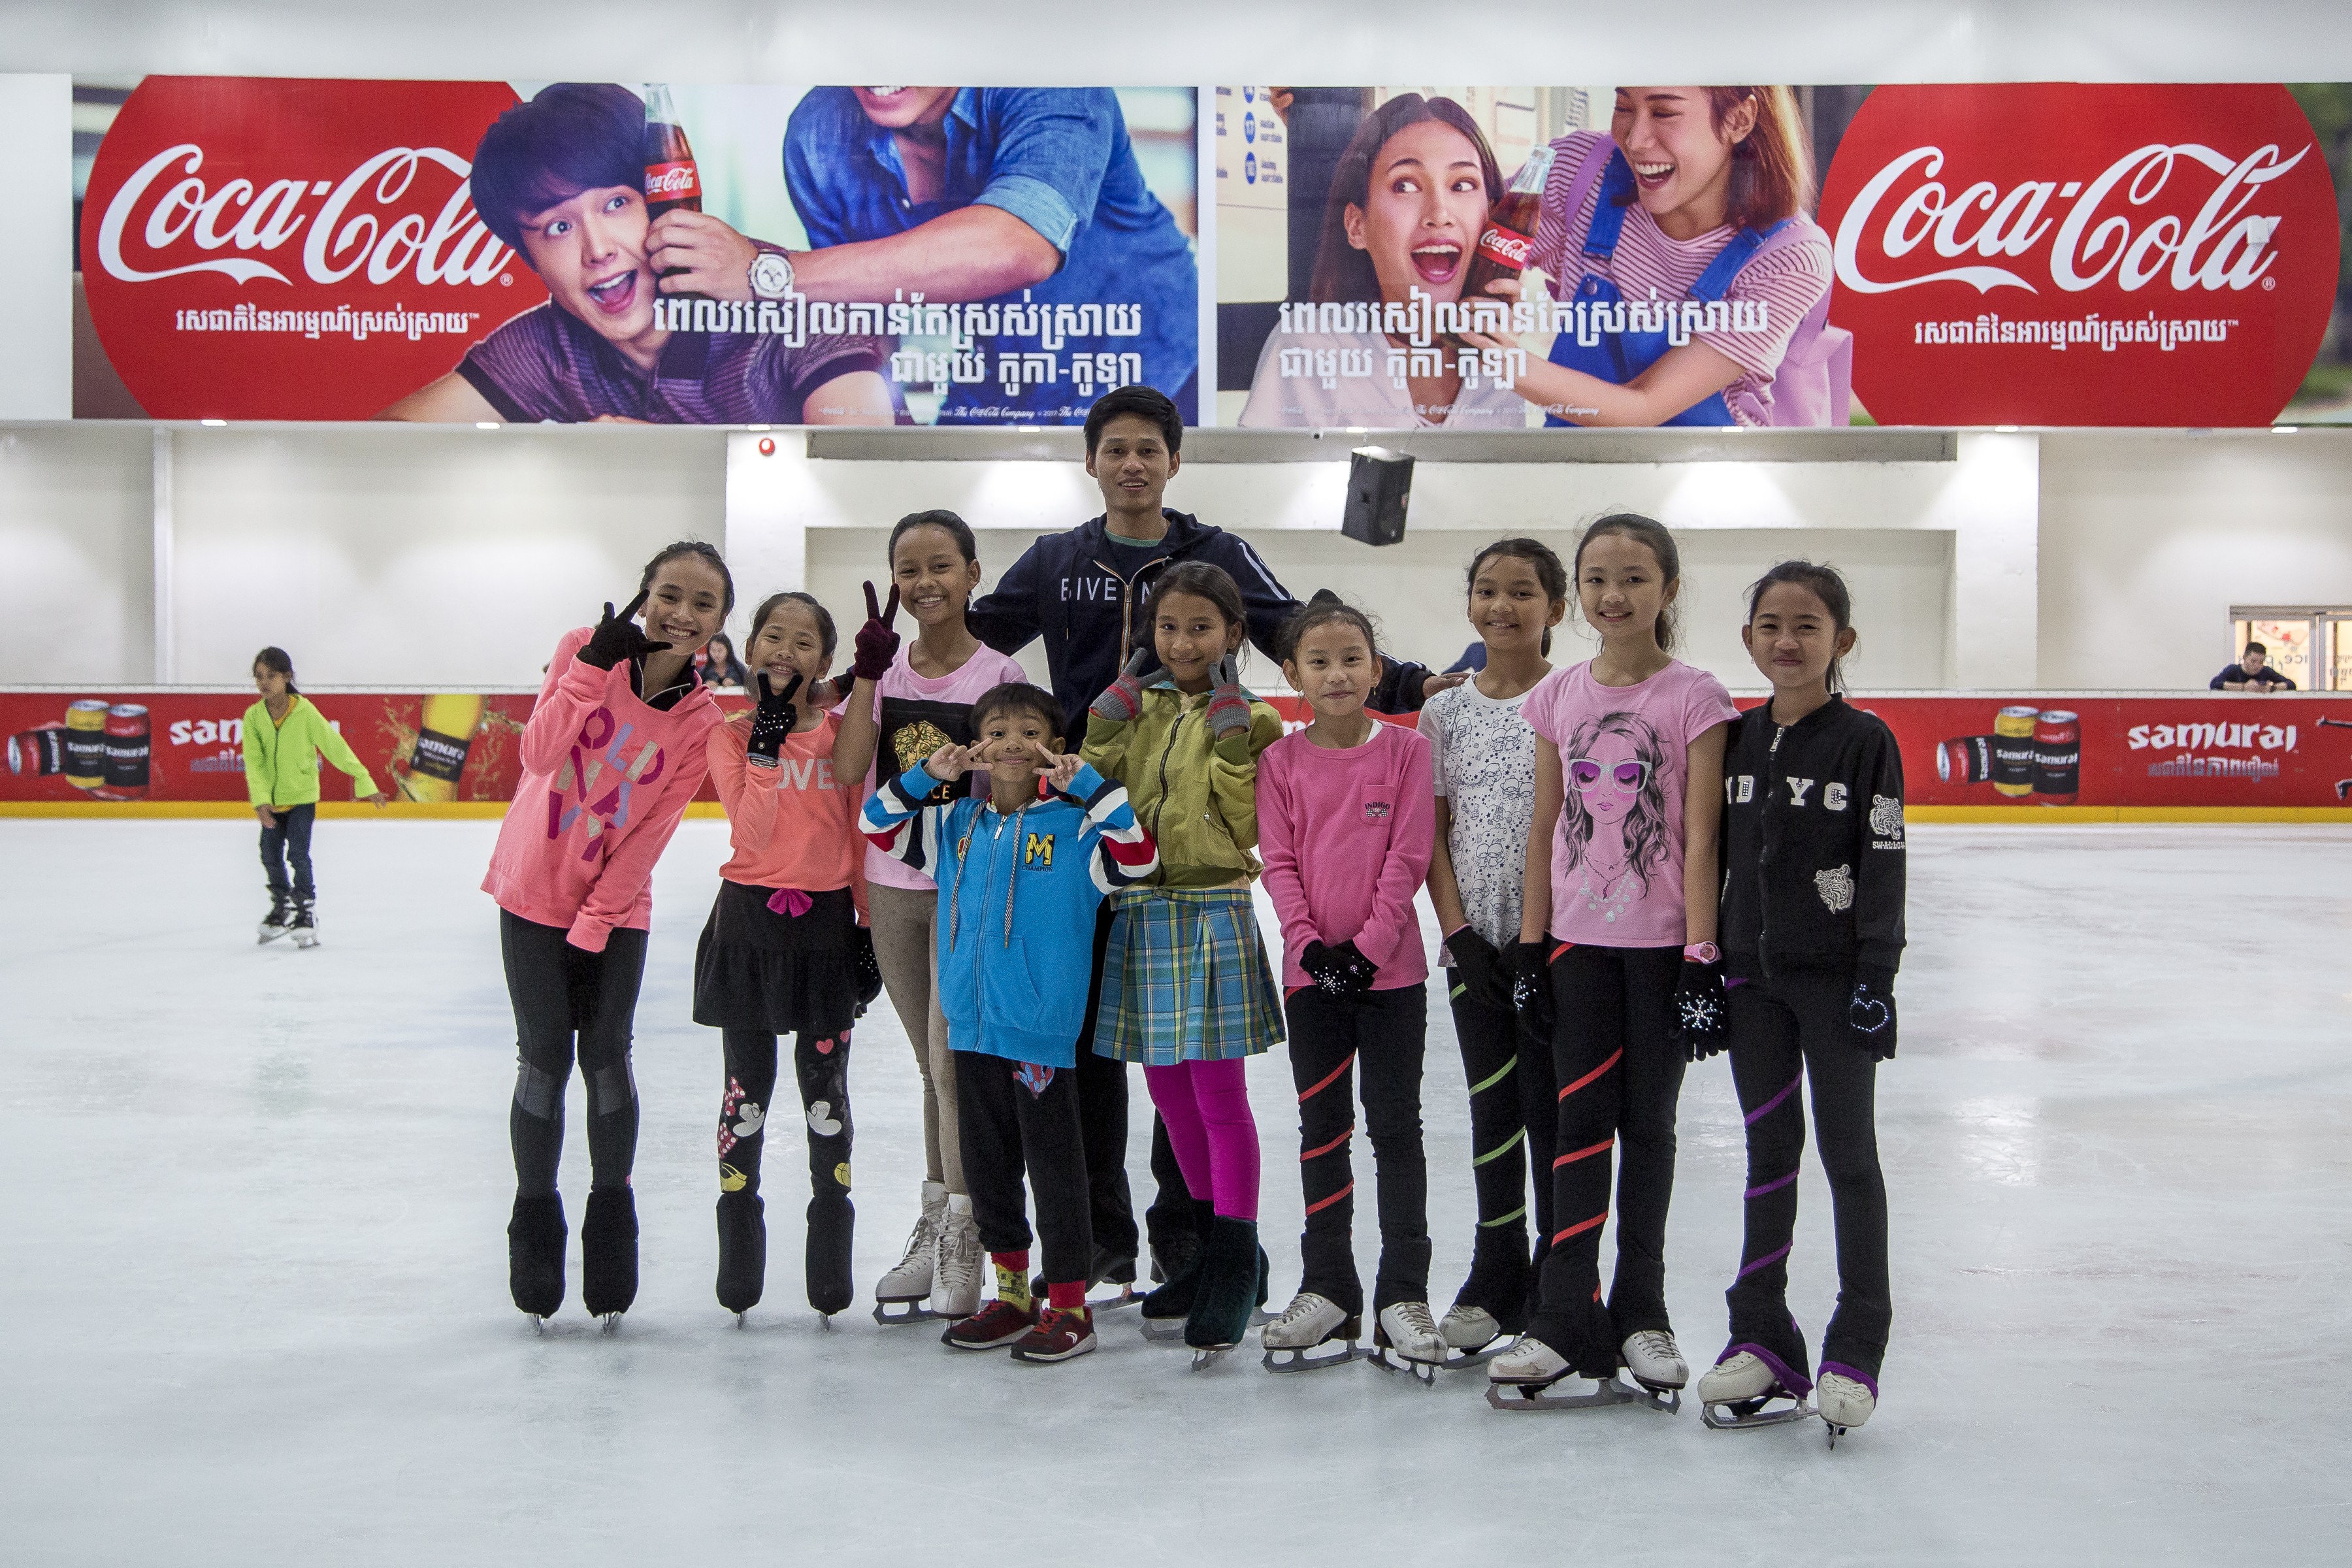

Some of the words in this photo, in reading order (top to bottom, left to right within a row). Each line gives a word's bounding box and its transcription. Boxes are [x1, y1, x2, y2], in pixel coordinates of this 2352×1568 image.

[98, 143, 515, 286] Coca-Cola
[1835, 142, 2311, 294] Coca-Cola
[1480, 229, 1531, 263] Coca-Cola
[1001, 406, 1036, 419] Company
[2127, 721, 2297, 753] samurai
[1364, 801, 1391, 810] INDIGO
[1024, 832, 1056, 866] M
[1021, 864, 1054, 872] CHAMPION
